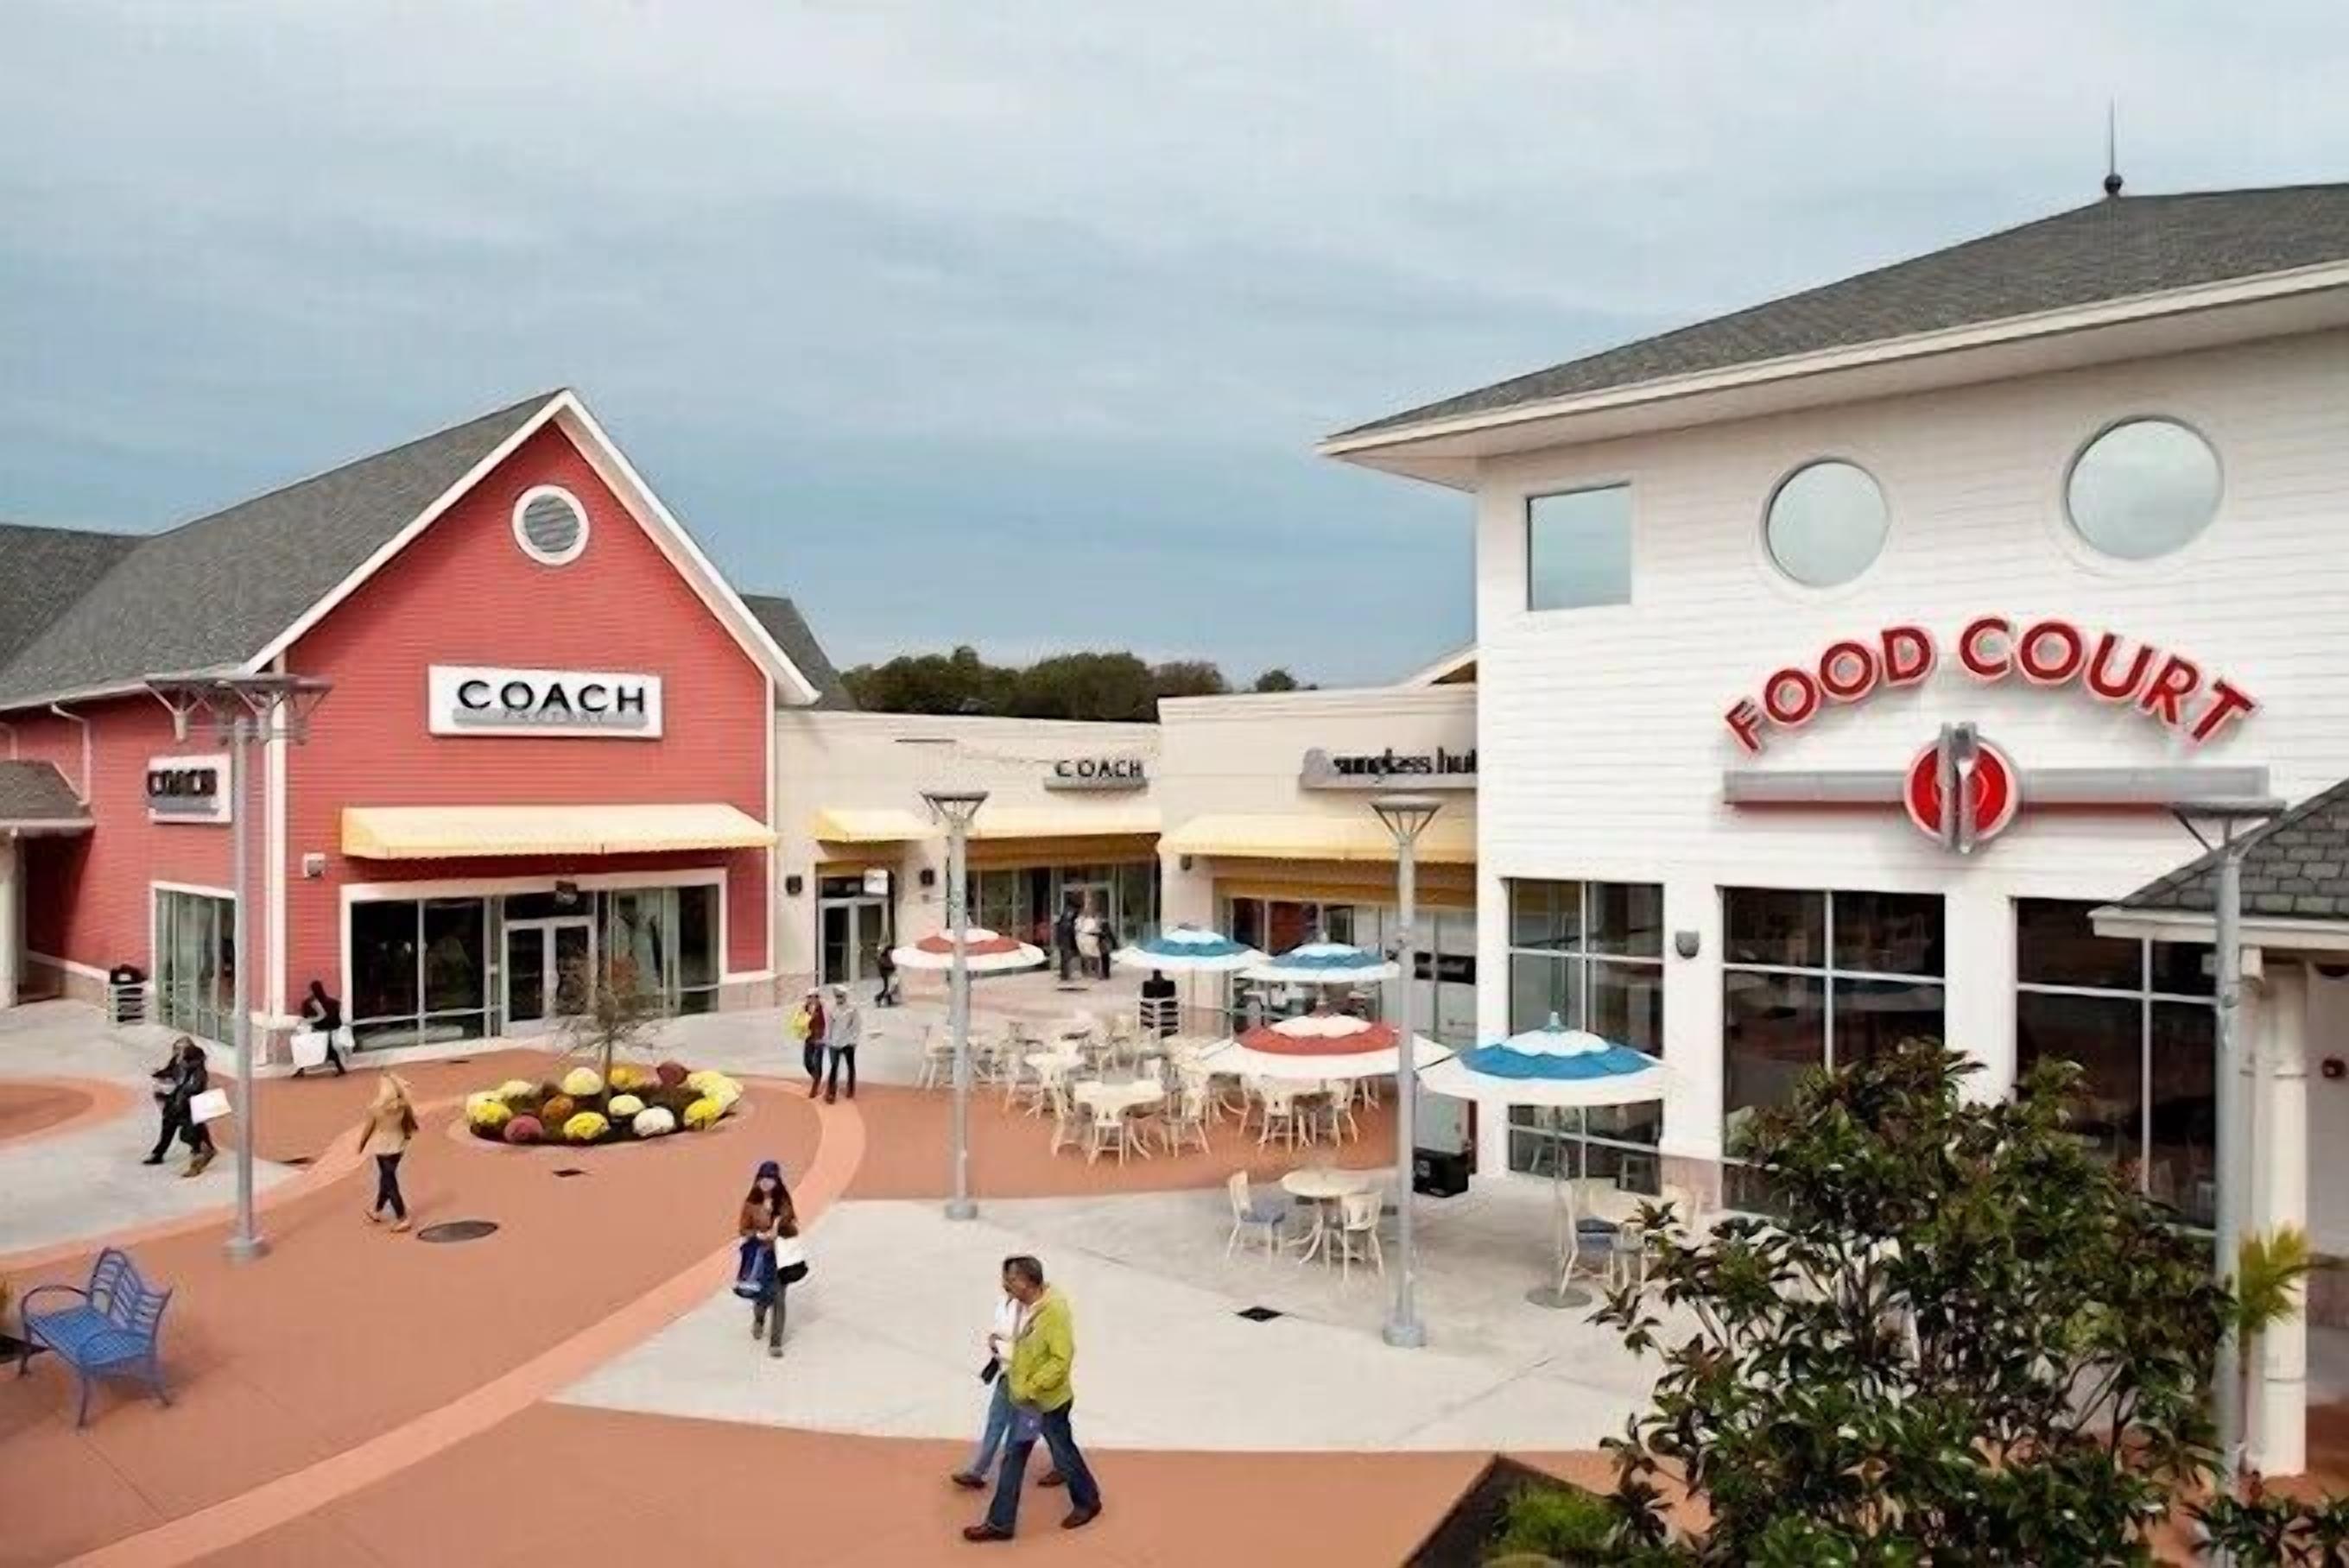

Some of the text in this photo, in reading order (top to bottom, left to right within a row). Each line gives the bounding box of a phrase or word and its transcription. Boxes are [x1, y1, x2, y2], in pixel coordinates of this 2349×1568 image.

[457, 680, 646, 714] COACH
[1724, 618, 2256, 751] FOOD COURT
[1054, 759, 1143, 777] COACH
